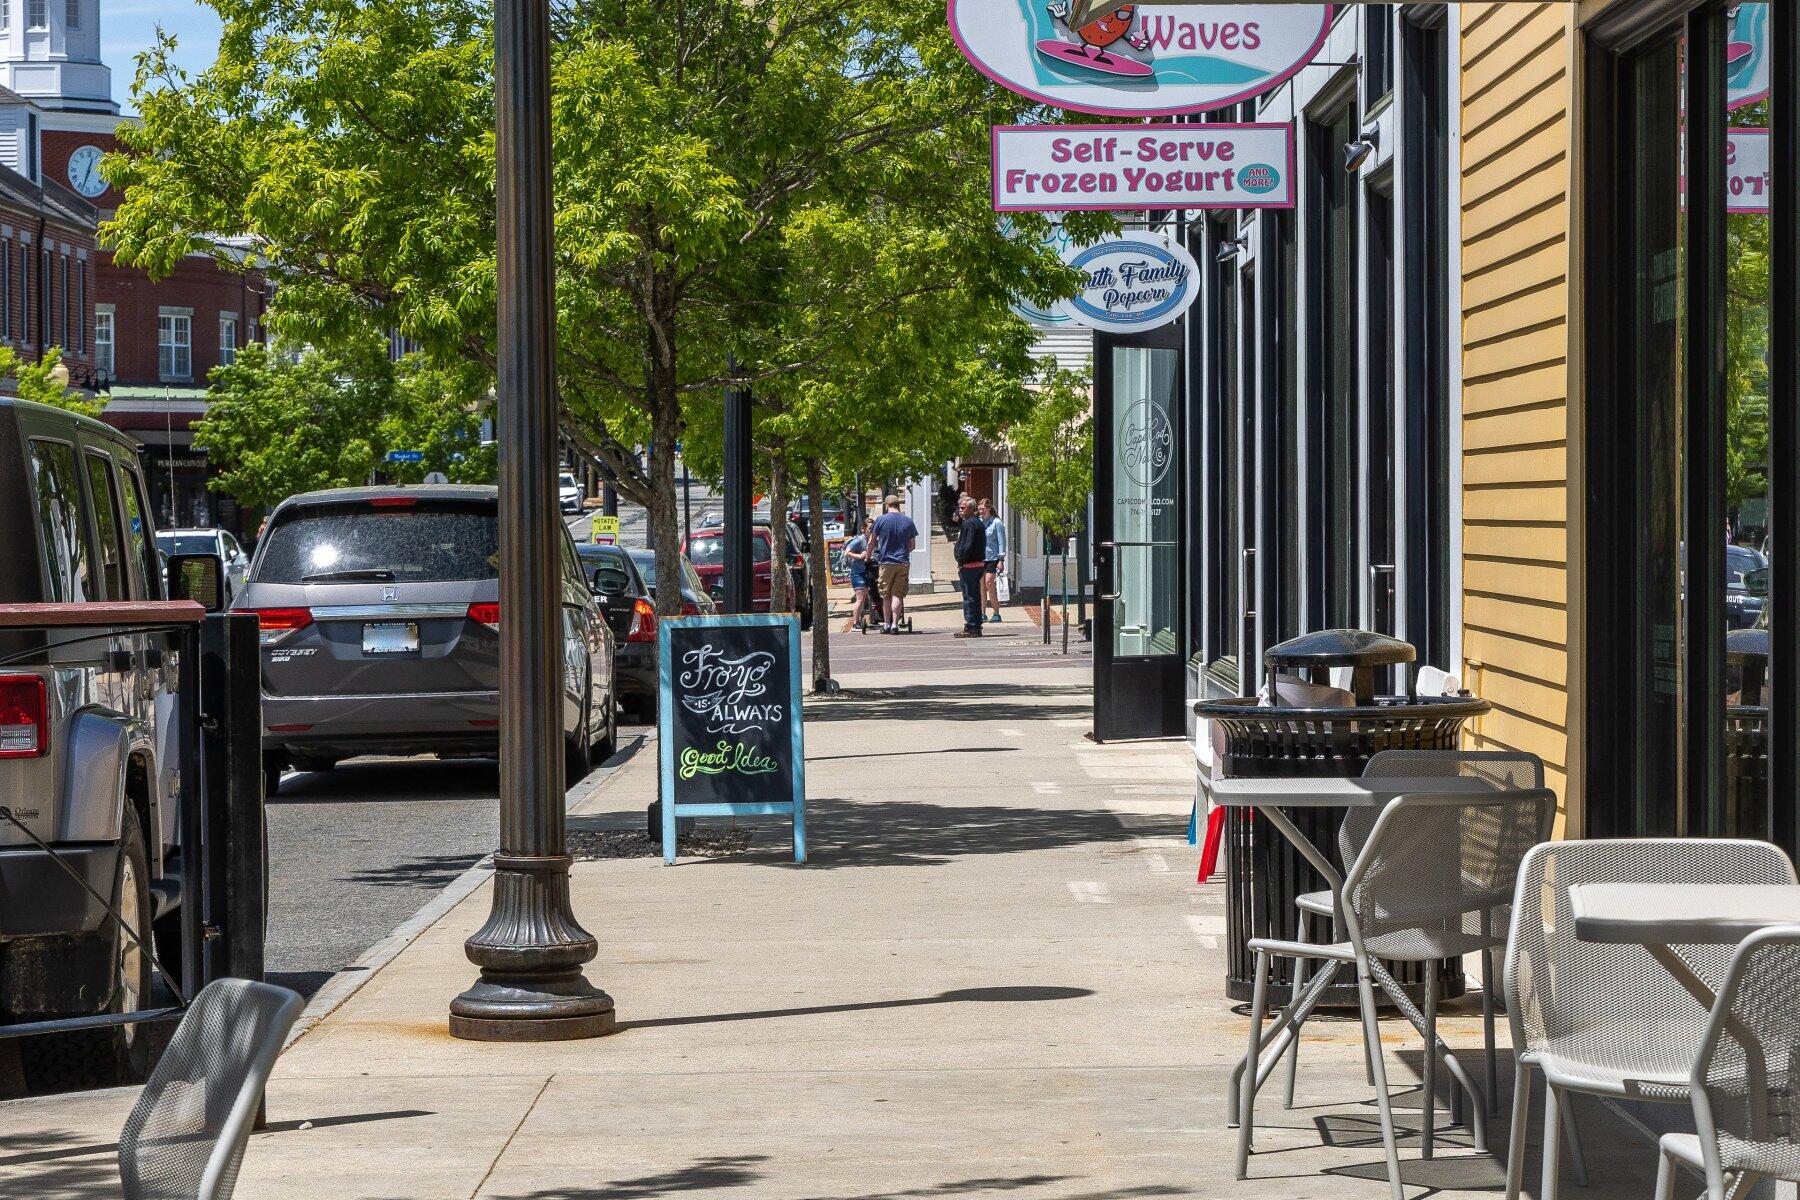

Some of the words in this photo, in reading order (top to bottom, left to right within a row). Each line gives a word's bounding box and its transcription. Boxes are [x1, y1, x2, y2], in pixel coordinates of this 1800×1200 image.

[1141, 15, 1260, 50] Waves
[1051, 137, 1235, 163] Self-Serve
[1006, 168, 1117, 193] Frozen
[1123, 167, 1235, 193] Yogurt
[1243, 178, 1274, 187] MORE!
[1248, 168, 1268, 176] AND
[1119, 258, 1188, 289] Family
[1103, 288, 1168, 309] Popcorn
[711, 704, 782, 721] ALWAYS
[727, 743, 778, 774] Idea
